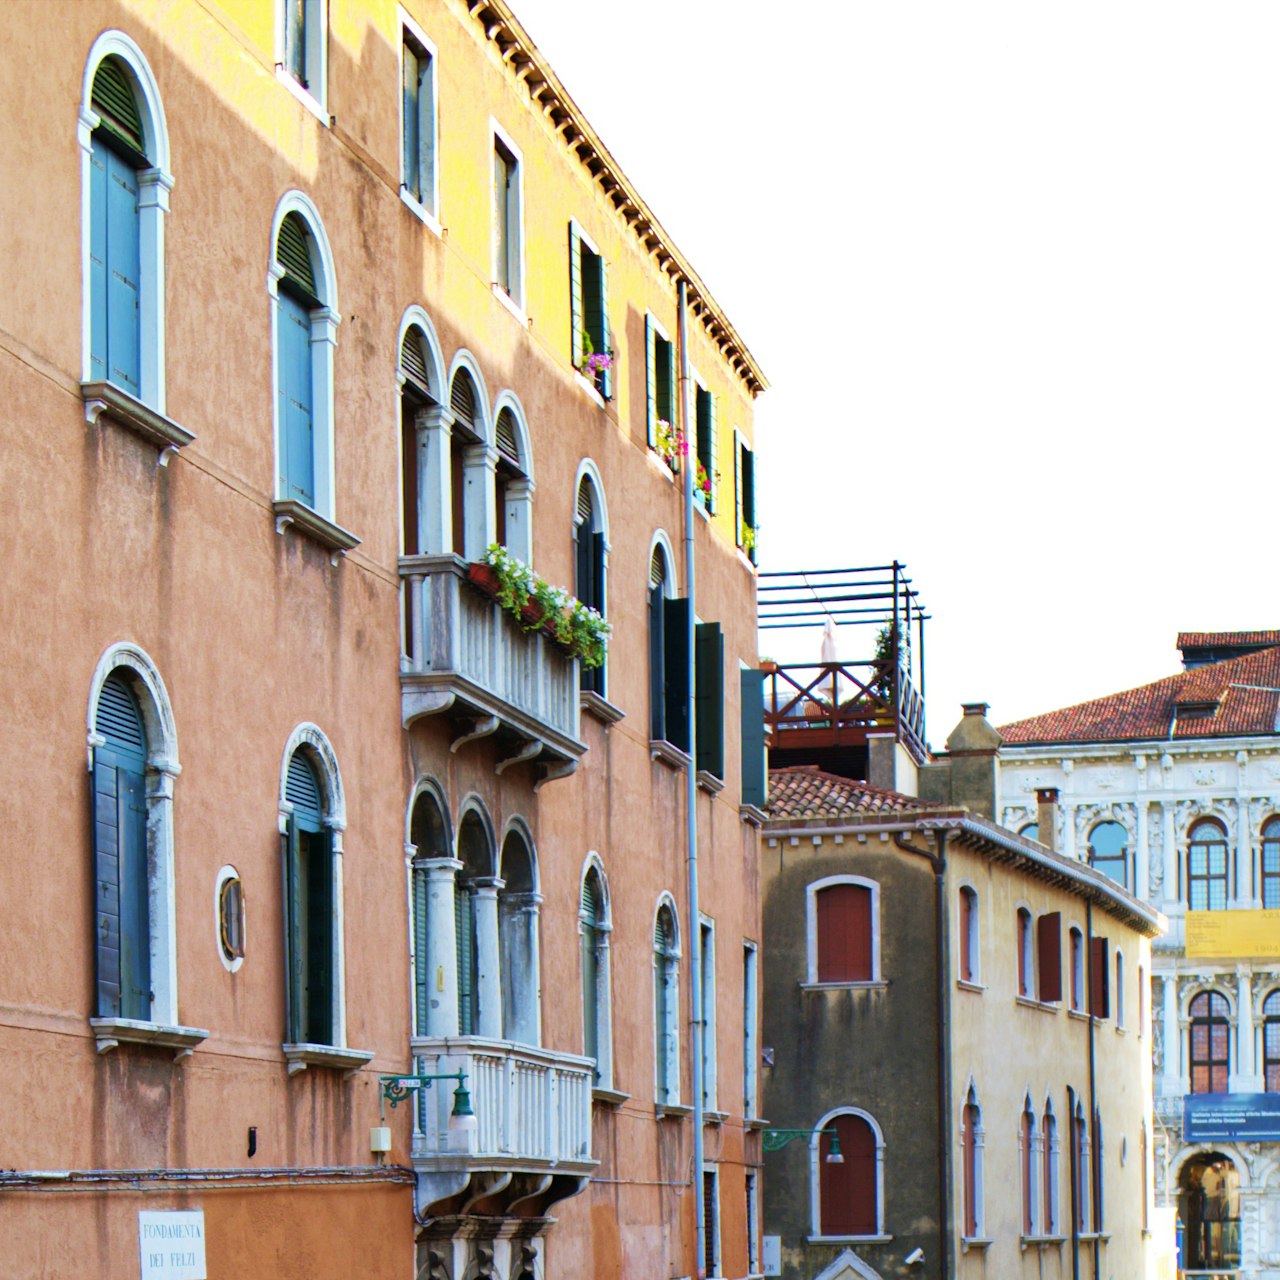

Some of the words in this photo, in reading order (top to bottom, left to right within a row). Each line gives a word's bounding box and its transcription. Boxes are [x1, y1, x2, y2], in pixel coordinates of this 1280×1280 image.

[143, 1223, 201, 1239] FONDAMENTA
[149, 1253, 164, 1268] DEI
[170, 1252, 195, 1267] FELZI
